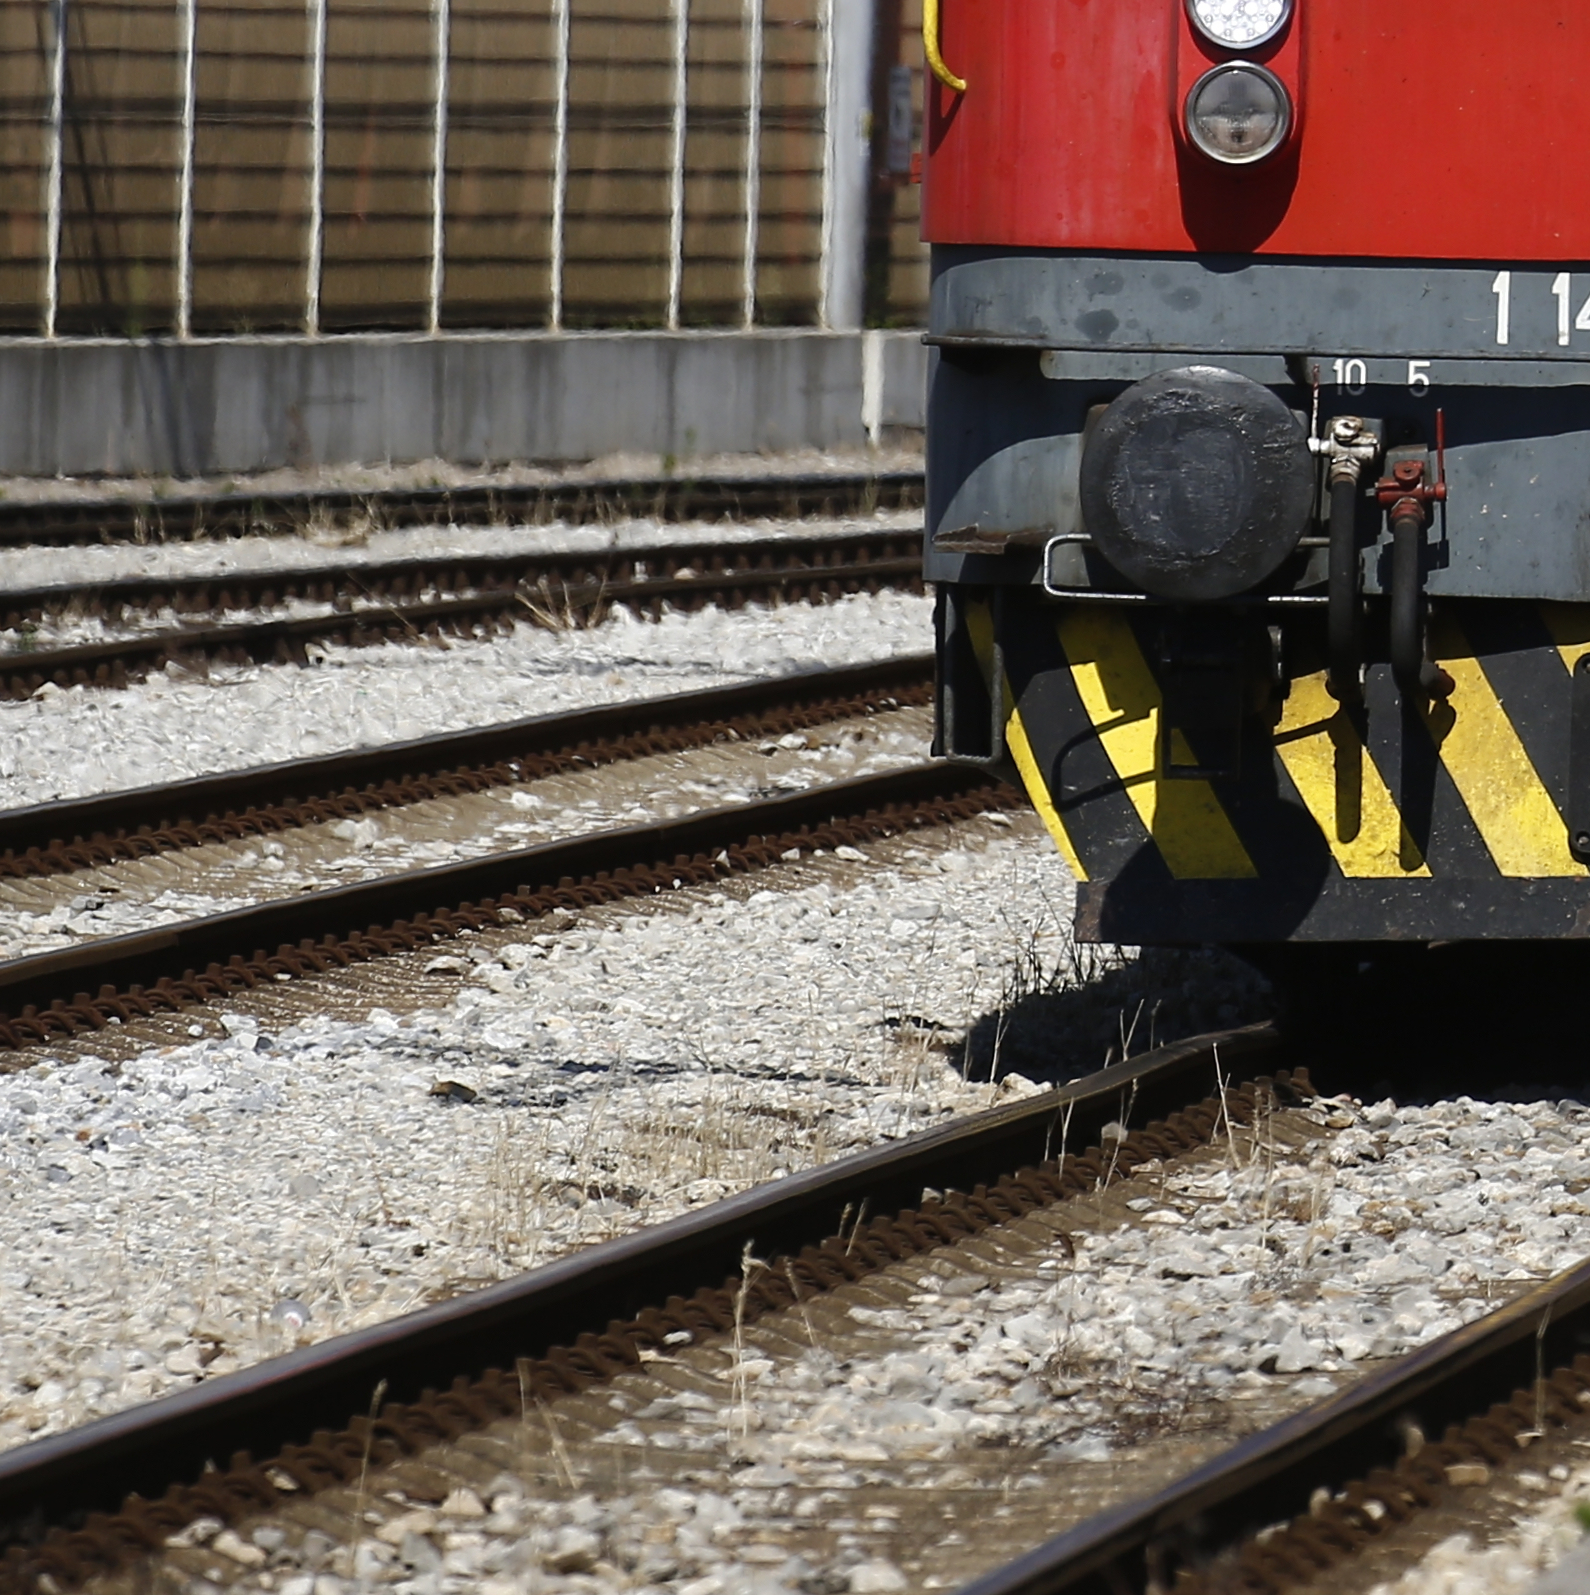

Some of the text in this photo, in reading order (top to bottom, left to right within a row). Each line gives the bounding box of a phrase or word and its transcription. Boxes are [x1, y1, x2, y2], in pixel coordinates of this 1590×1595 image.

[1492, 271, 1511, 345] 1
[1332, 359, 1431, 397] 10 5
